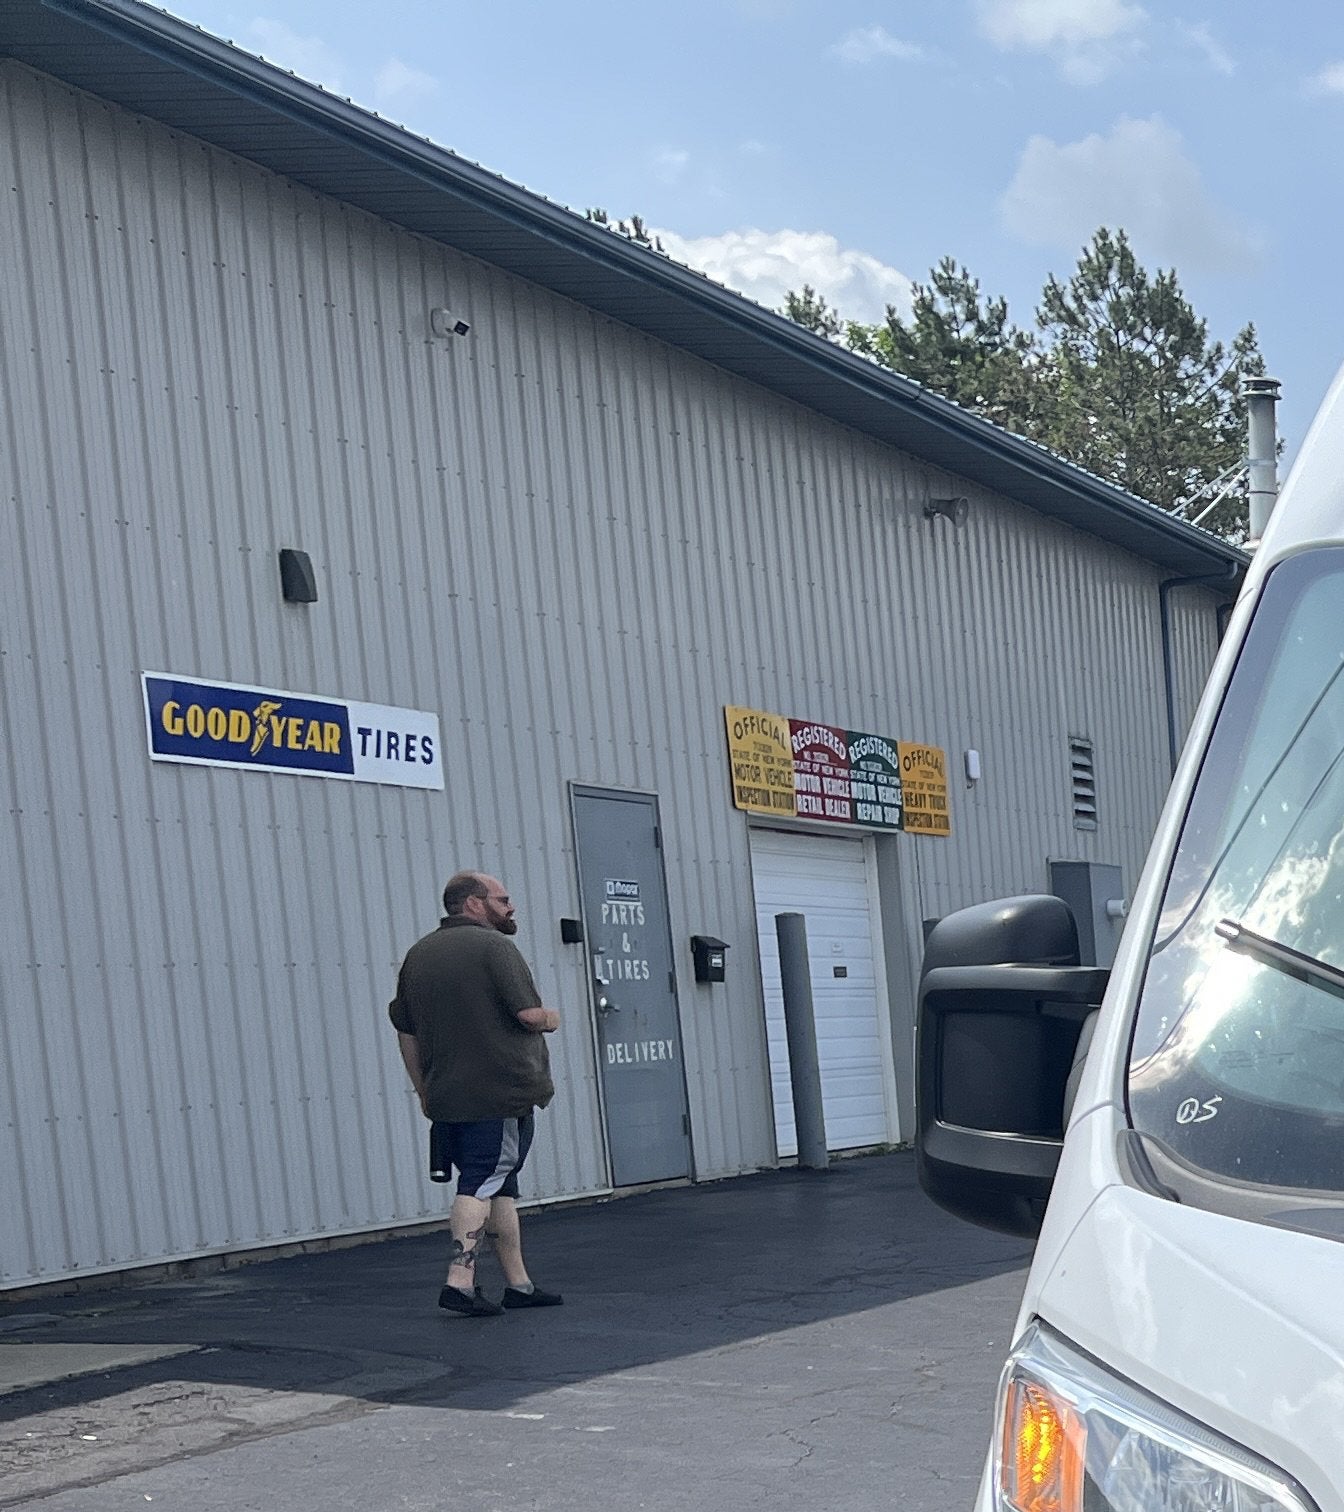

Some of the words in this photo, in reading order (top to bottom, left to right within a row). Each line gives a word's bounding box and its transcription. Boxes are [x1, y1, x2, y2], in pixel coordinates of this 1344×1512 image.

[161, 700, 342, 756] GOODYEAR
[356, 726, 435, 765] TIRES
[733, 715, 786, 751] OFFICIAL
[791, 725, 847, 760] REGISTERED
[848, 737, 898, 770] REGISTERED
[903, 749, 944, 778] OFFICIAL
[734, 763, 761, 784] MOTOR
[601, 903, 645, 926] PARTS
[622, 932, 631, 953] &
[607, 959, 651, 981] TIRES
[606, 1039, 674, 1065] DELIVERY
